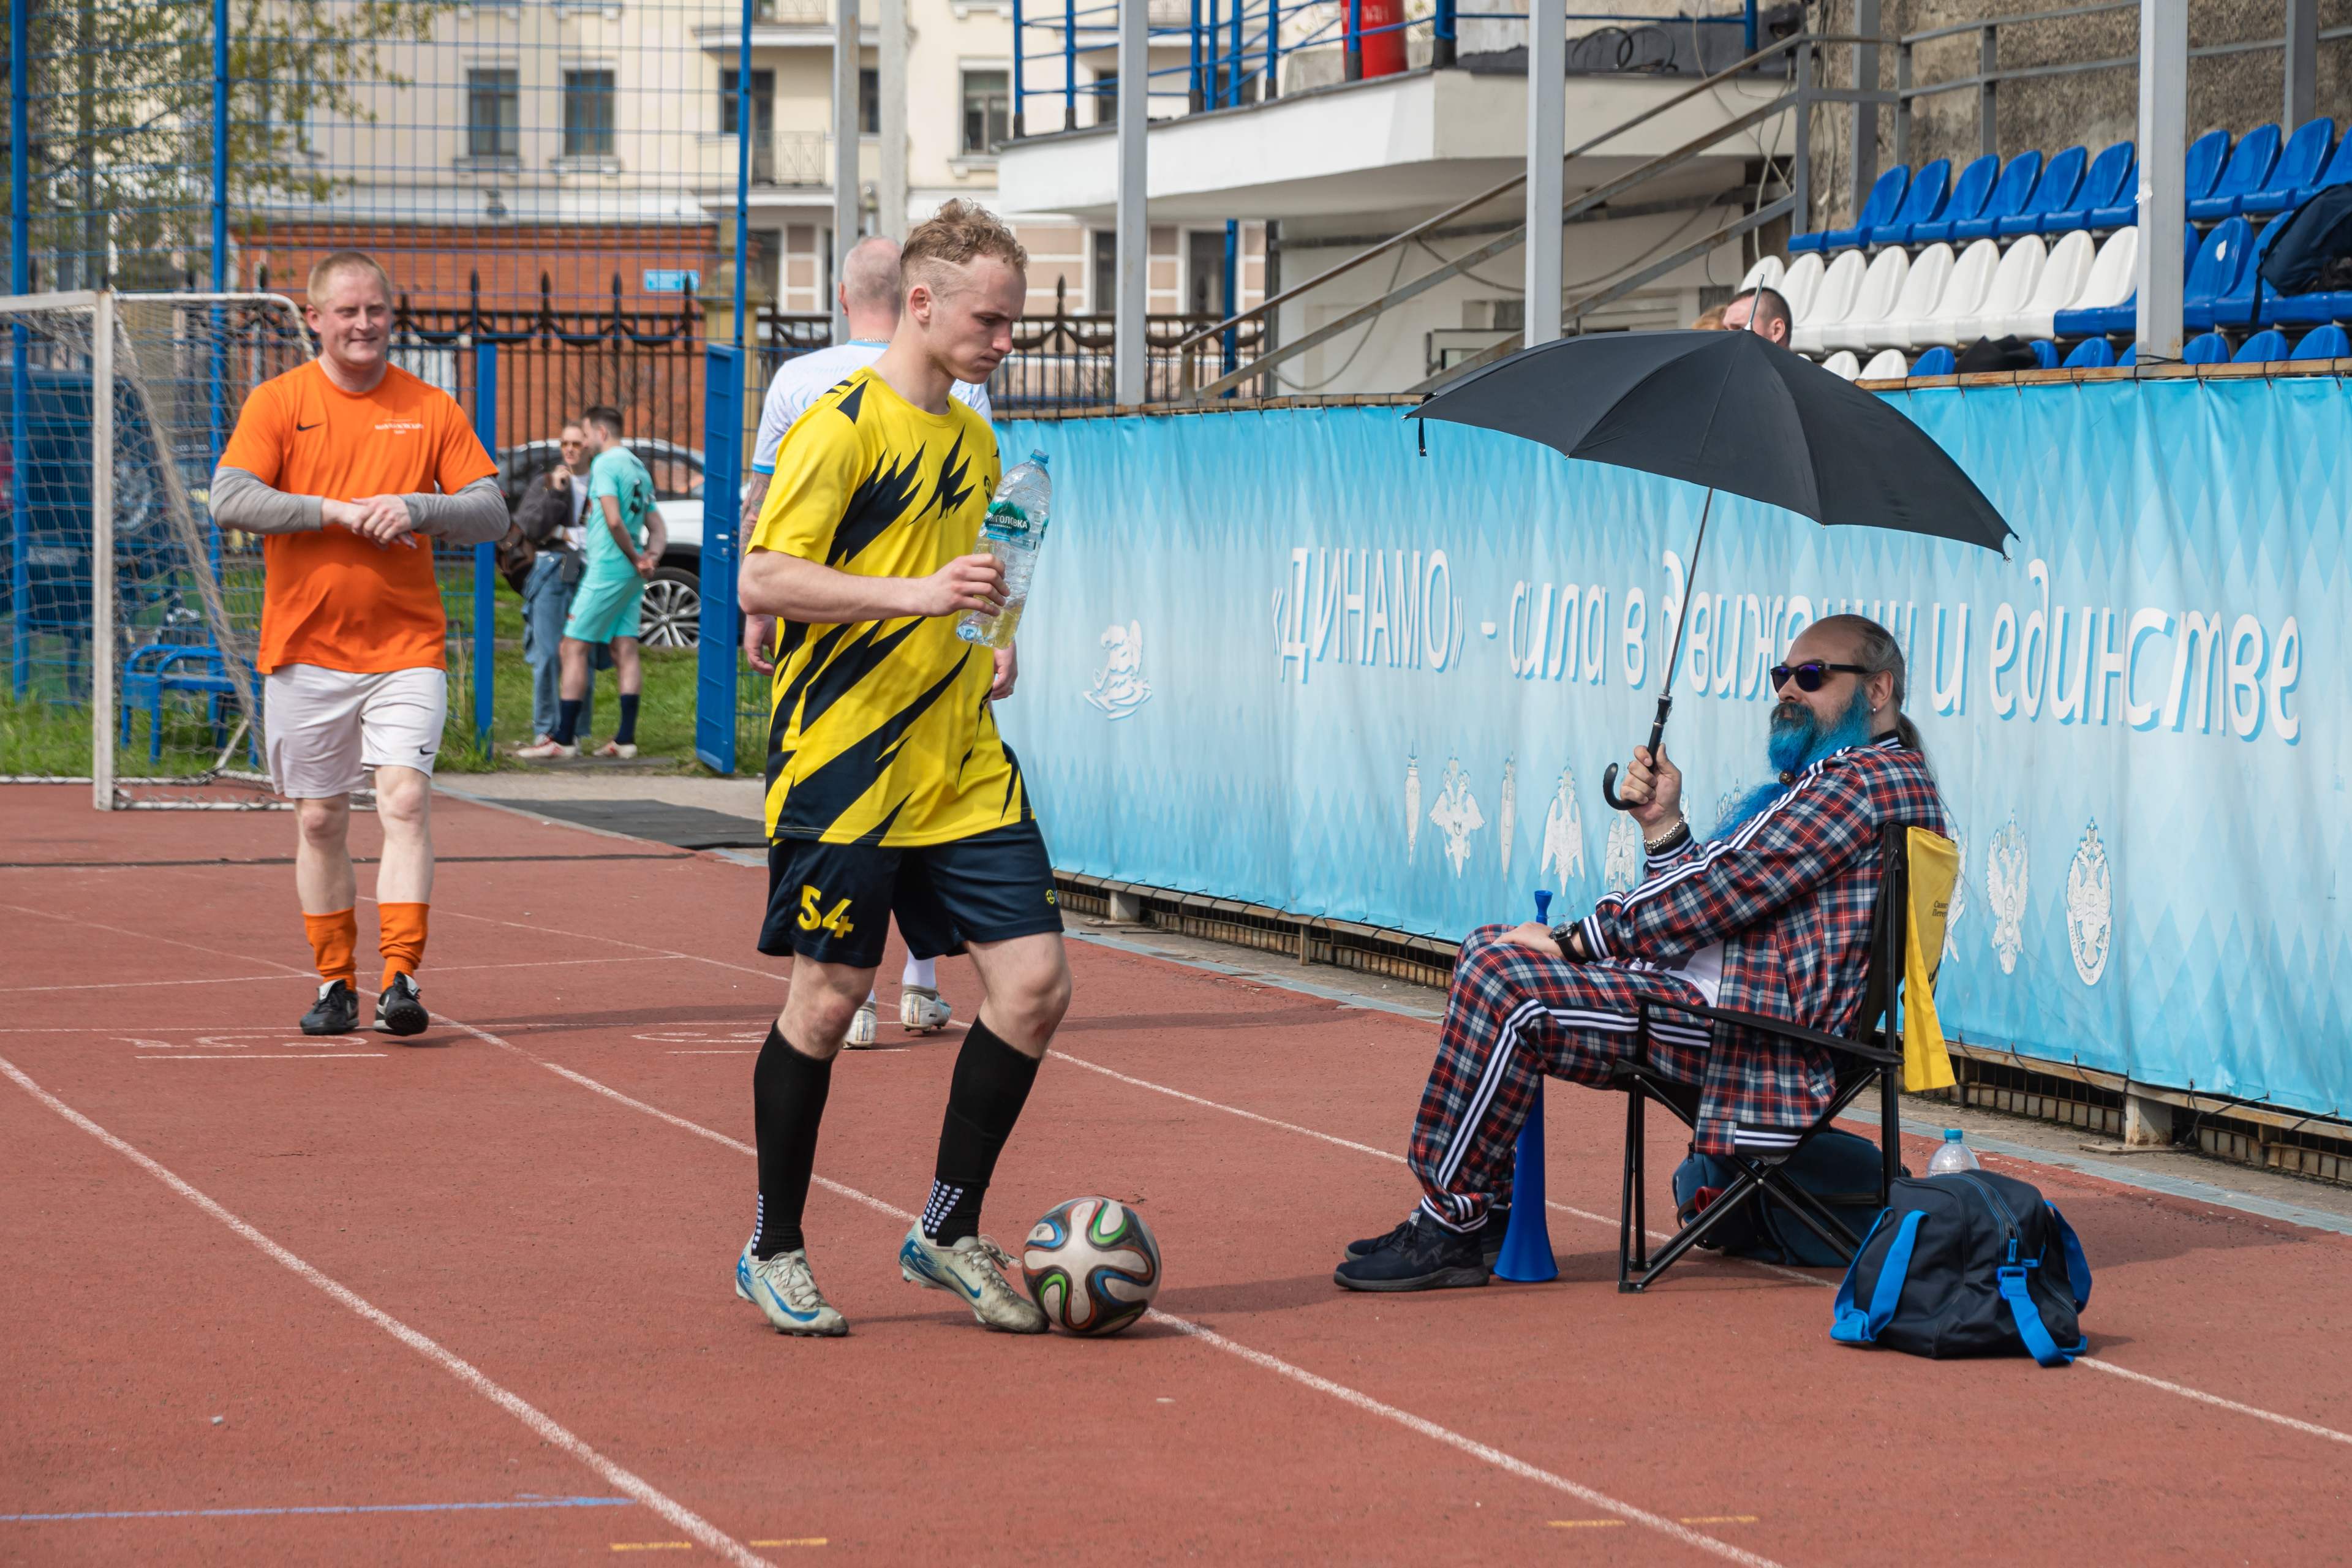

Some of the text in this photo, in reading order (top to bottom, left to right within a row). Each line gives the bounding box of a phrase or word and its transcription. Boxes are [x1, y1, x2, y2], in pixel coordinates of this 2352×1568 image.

[1272, 547, 1464, 680] «ДИНАМО»
[1509, 579, 1606, 681] сила
[1623, 587, 1646, 686] в
[1932, 603, 1967, 712] и
[1989, 559, 2302, 740] единстве
[797, 884, 854, 938] 54
